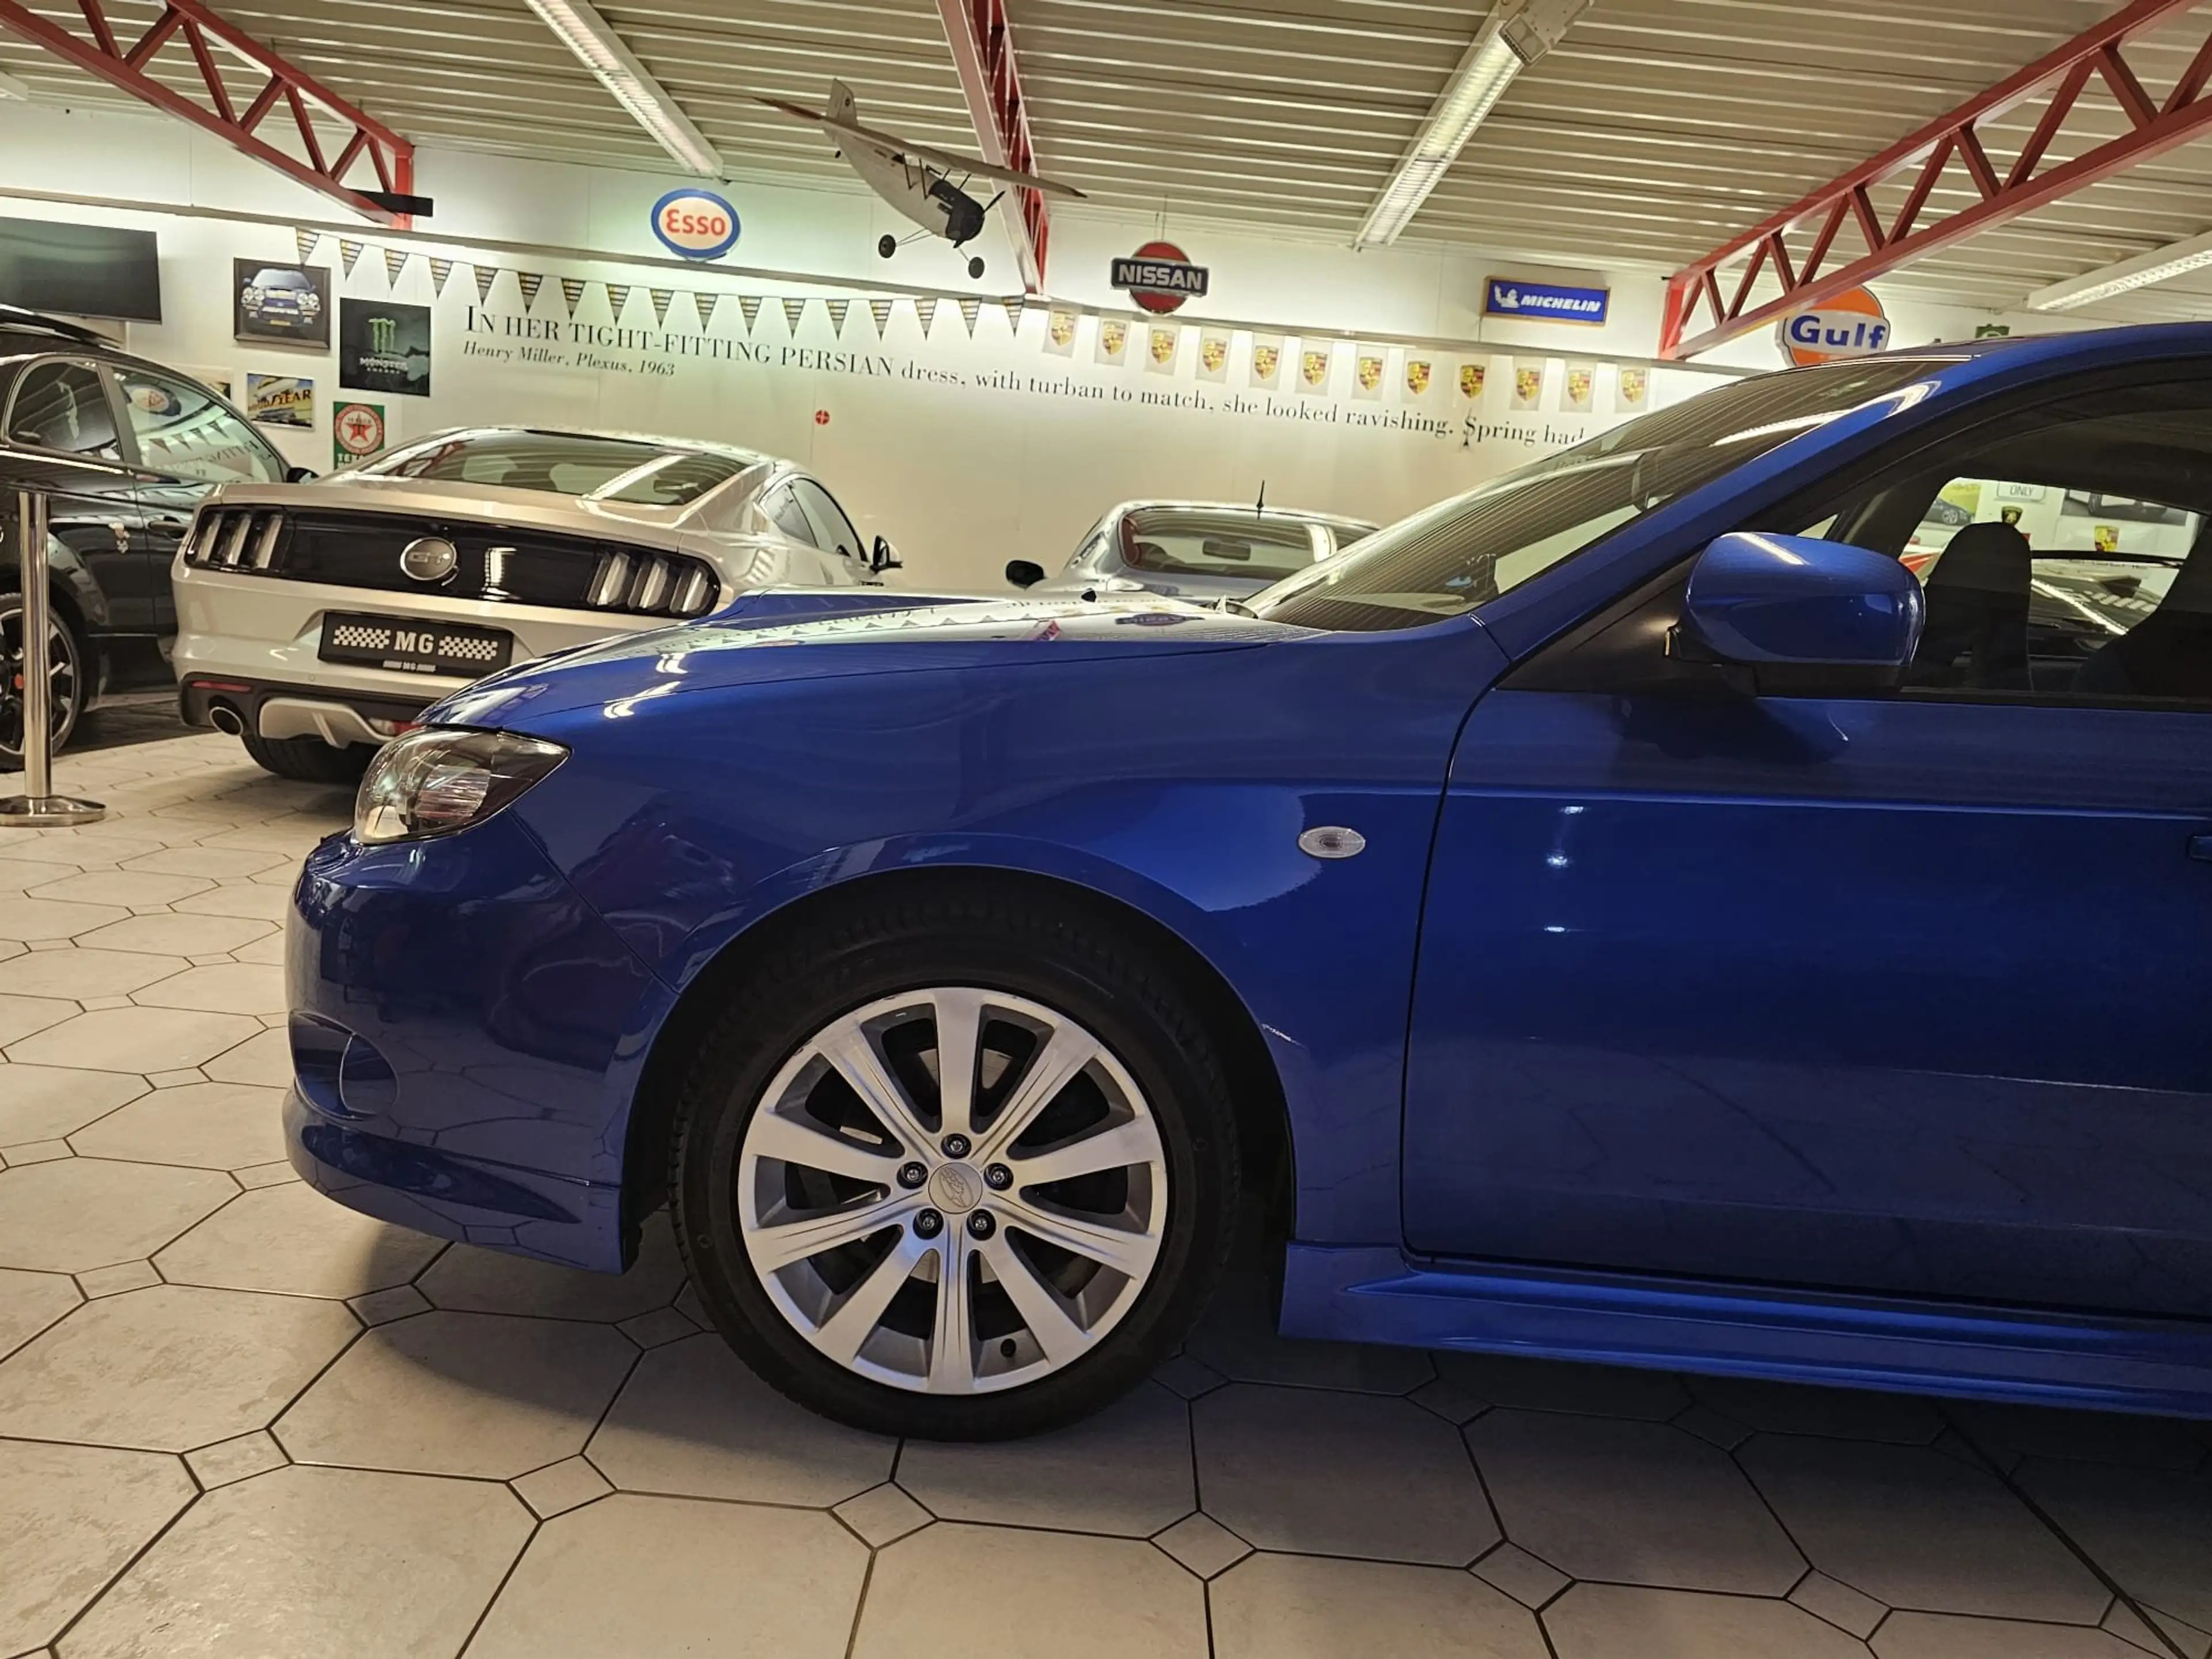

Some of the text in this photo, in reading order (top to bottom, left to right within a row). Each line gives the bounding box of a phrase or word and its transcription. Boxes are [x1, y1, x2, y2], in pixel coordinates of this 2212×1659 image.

[1118, 263, 1202, 290] NISSAN
[1521, 294, 1601, 313] MICHELIN
[1790, 314, 1886, 349] Gulf
[463, 340, 676, 377] Henry Miller, Plexus, 1963
[505, 316, 559, 341] HER
[567, 322, 771, 364] TIGHT-FITTING
[781, 347, 895, 377] PERSIAN
[901, 359, 967, 389] dress,
[976, 370, 1020, 391] with
[1029, 377, 1103, 400] turban
[1112, 385, 1132, 403] to
[1141, 389, 1214, 414] match,
[1222, 394, 1258, 414] she
[1266, 397, 1338, 423] looked
[1346, 410, 1454, 440] ravishing.
[1464, 415, 1537, 448] Spring
[2009, 484, 2034, 497] ONLY
[393, 631, 434, 654] MG
